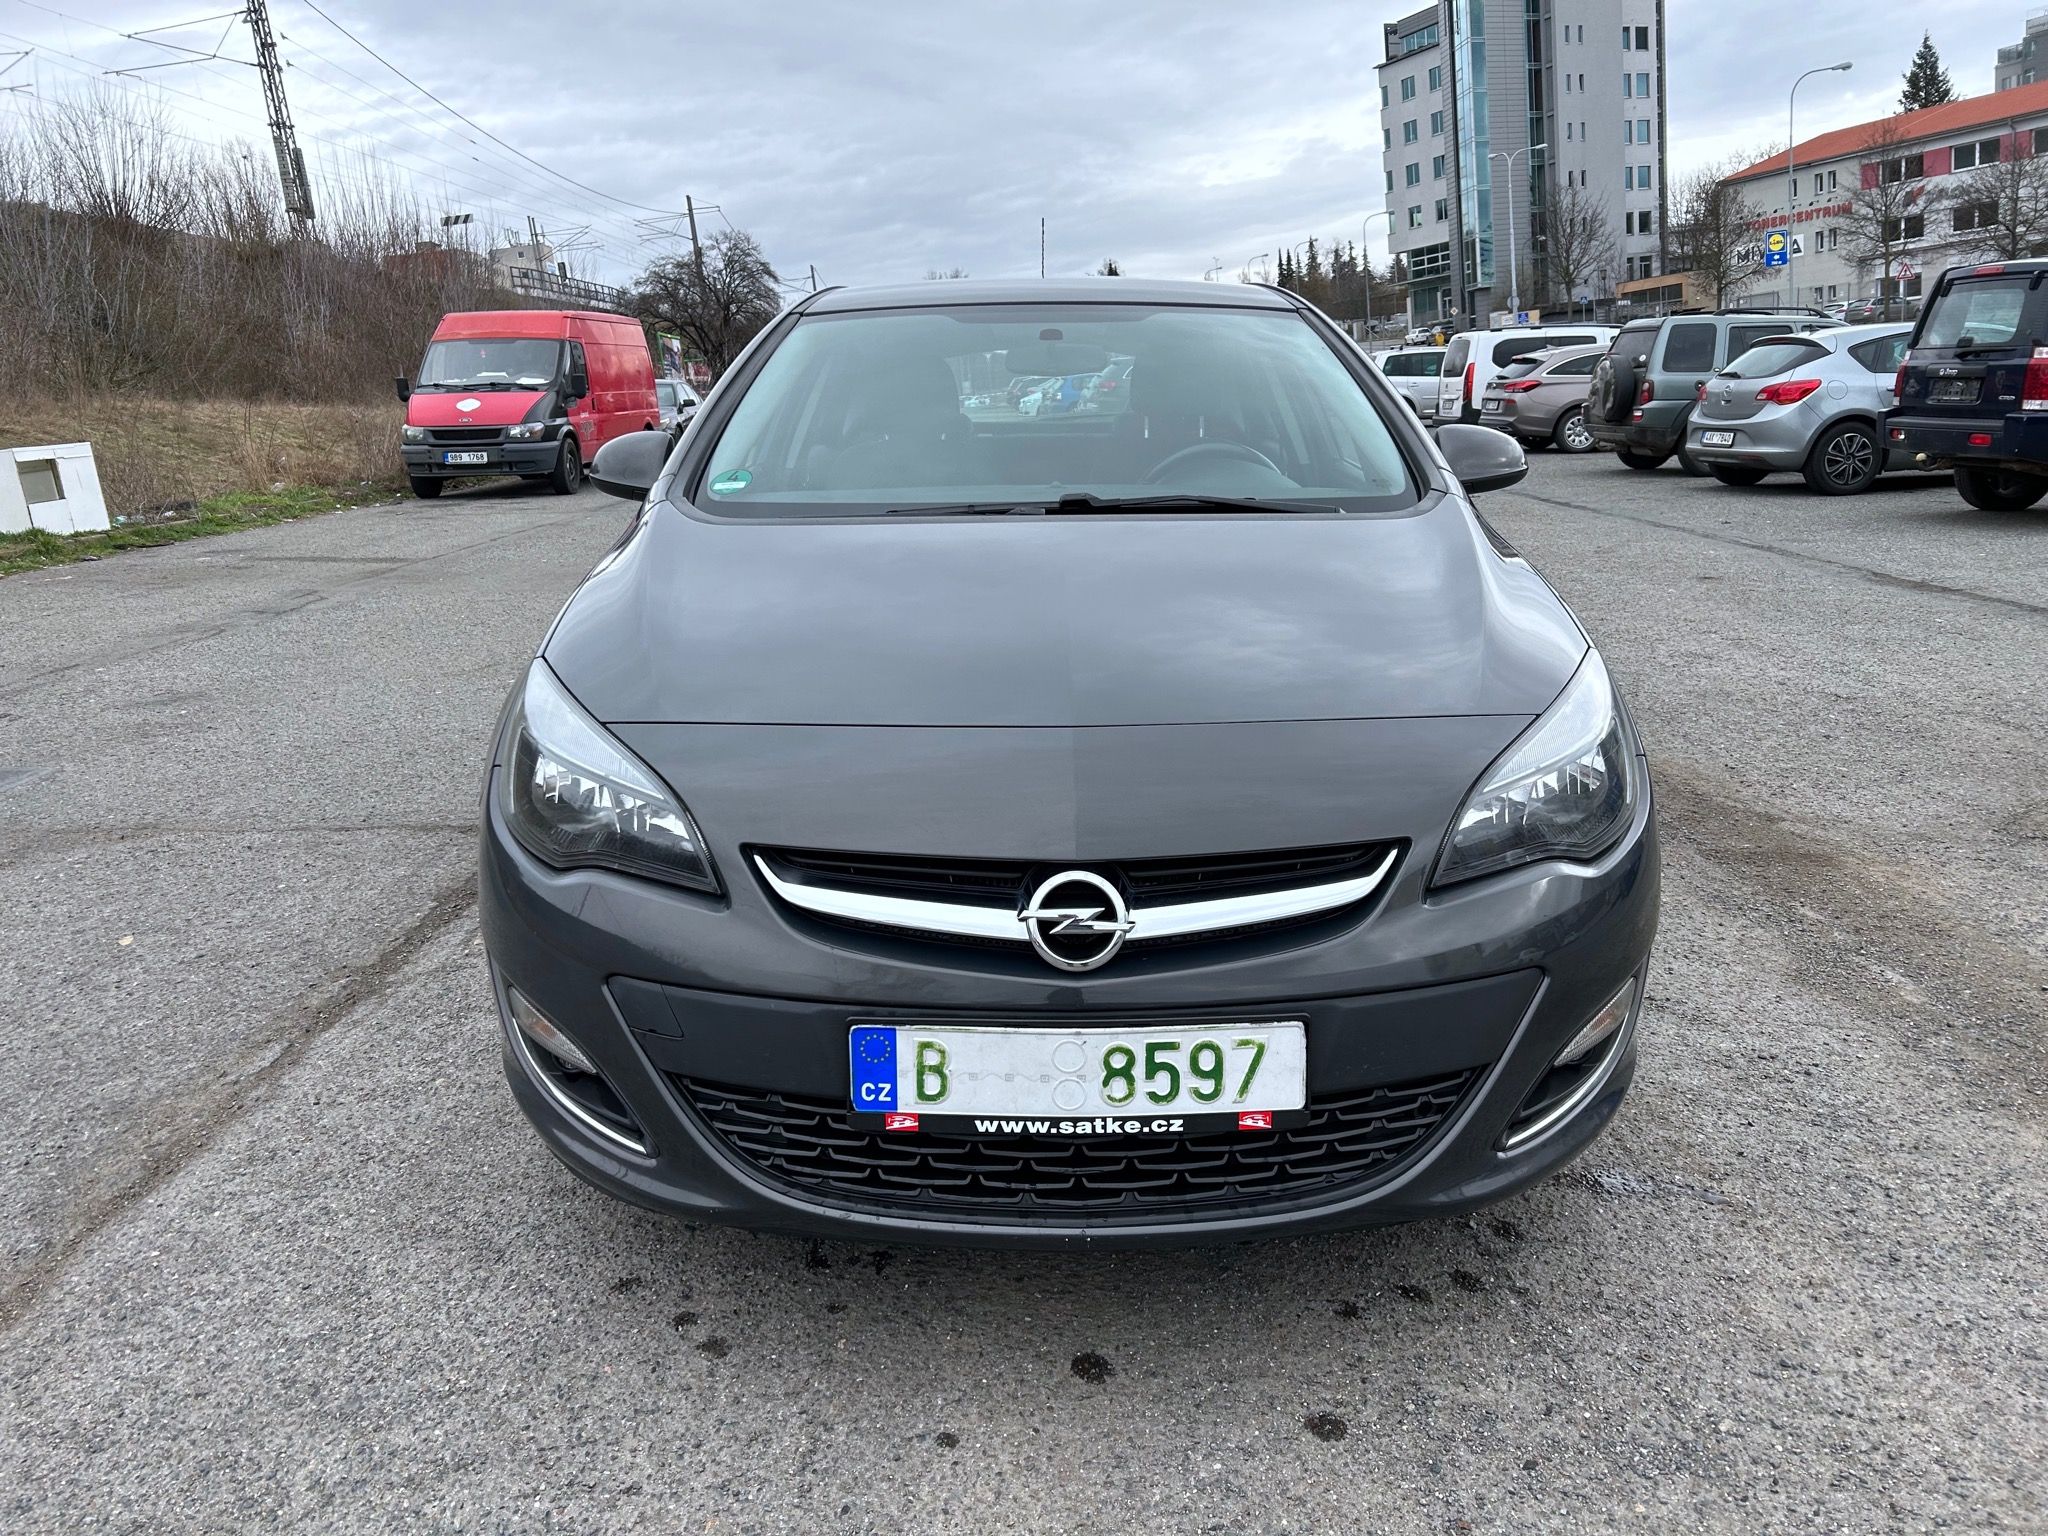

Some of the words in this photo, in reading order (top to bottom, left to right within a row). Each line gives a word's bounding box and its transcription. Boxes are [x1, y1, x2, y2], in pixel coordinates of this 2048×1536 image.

[467, 453, 485, 462] 1768
[914, 1038, 951, 1105] B
[1101, 1036, 1268, 1107] 8597
[861, 1082, 892, 1102] CZ
[974, 1117, 1184, 1135] www.satke.cz
